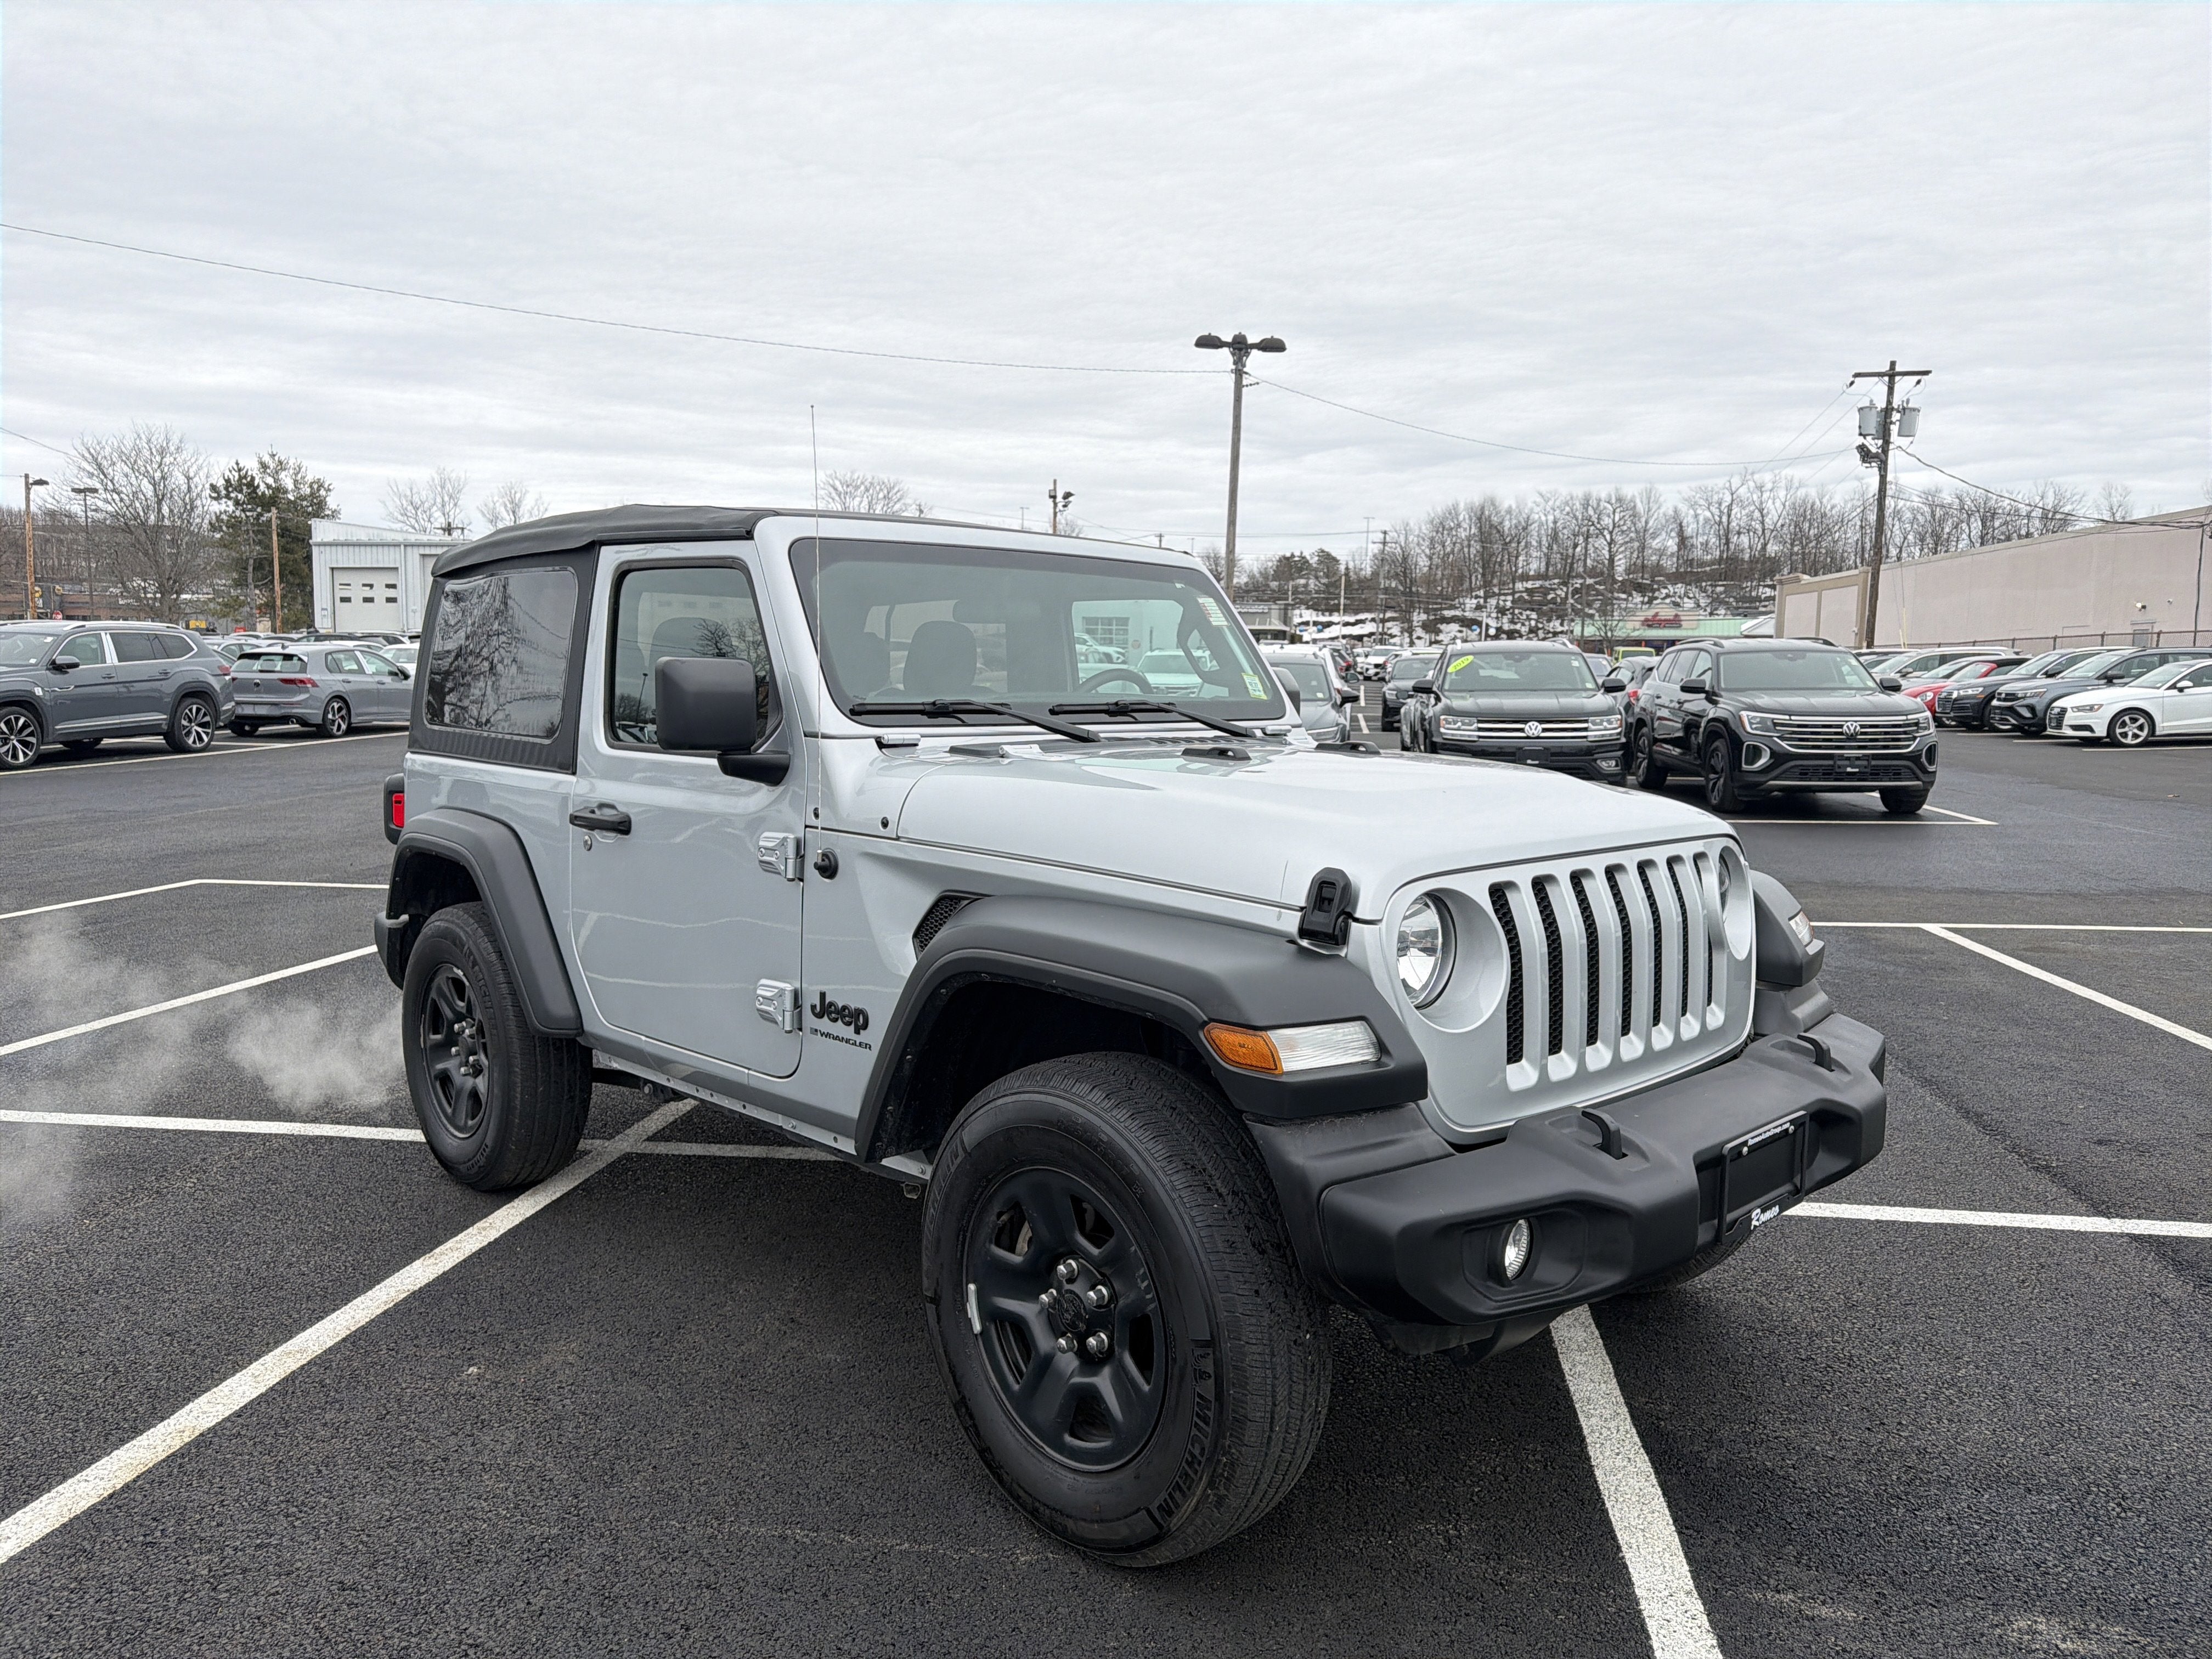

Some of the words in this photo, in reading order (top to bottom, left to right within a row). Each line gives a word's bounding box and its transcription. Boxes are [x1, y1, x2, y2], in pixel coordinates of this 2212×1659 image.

[810, 990, 869, 1035] Jeep
[818, 1029, 872, 1051] WRANGLER
[1751, 1205, 1780, 1231] Romeo
[1156, 1390, 1213, 1524] MICHELIN
